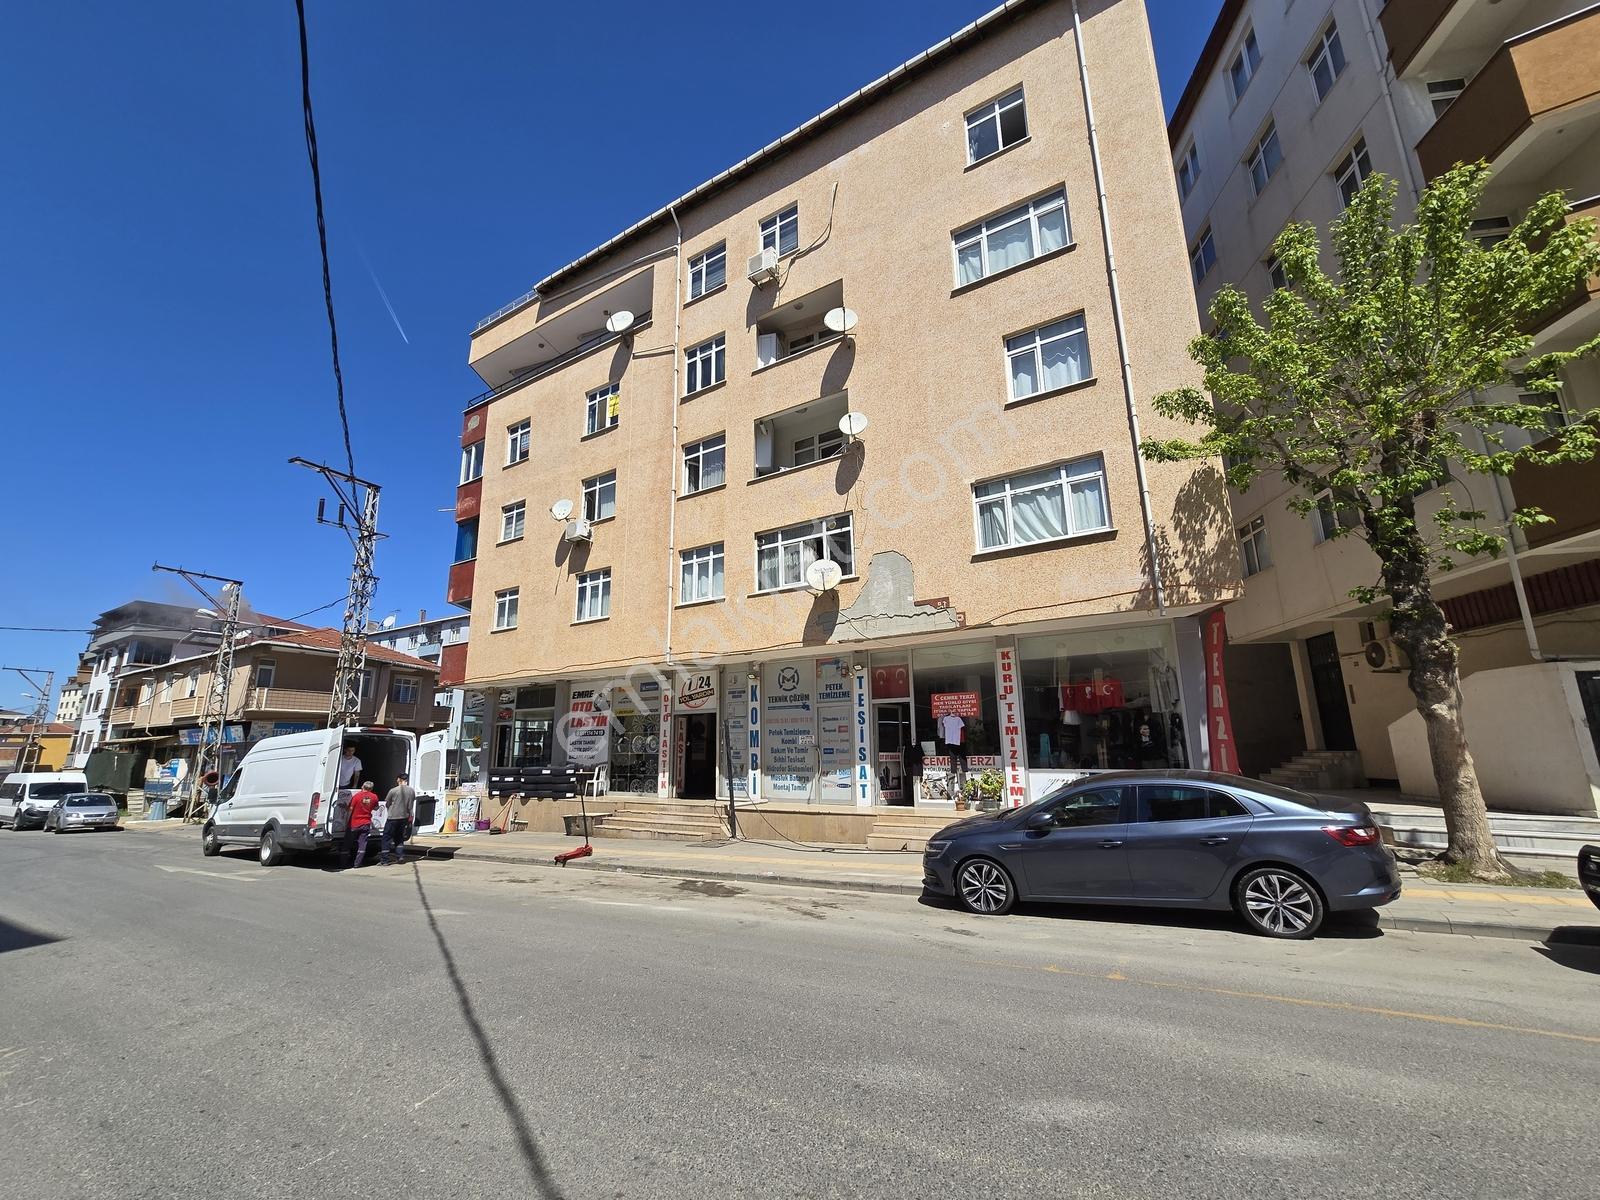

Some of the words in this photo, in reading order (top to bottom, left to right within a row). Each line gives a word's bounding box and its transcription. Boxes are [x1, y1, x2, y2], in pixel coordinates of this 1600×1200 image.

[1000, 650, 1014, 695] KURU
[825, 683, 844, 691] PETEK
[572, 690, 595, 699] EMRE
[768, 695, 789, 704] TEKNİK
[789, 693, 810, 703] ÇÖZÜM
[819, 690, 851, 700] TEMİZLEME
[1212, 622, 1228, 772] TERZİ
[571, 701, 594, 713] OTO
[662, 694, 671, 723] OTO
[569, 713, 608, 728] LASTİK
[768, 729, 783, 737] Petek
[784, 728, 811, 736] Temizleme
[856, 675, 868, 799] TESİSAT
[749, 684, 760, 795] KOMBİ
[781, 737, 798, 745] Kombi
[1005, 702, 1025, 808] TEMİZLEME
[788, 765, 814, 773] Sistemleri
[773, 783, 791, 793] Montaj
